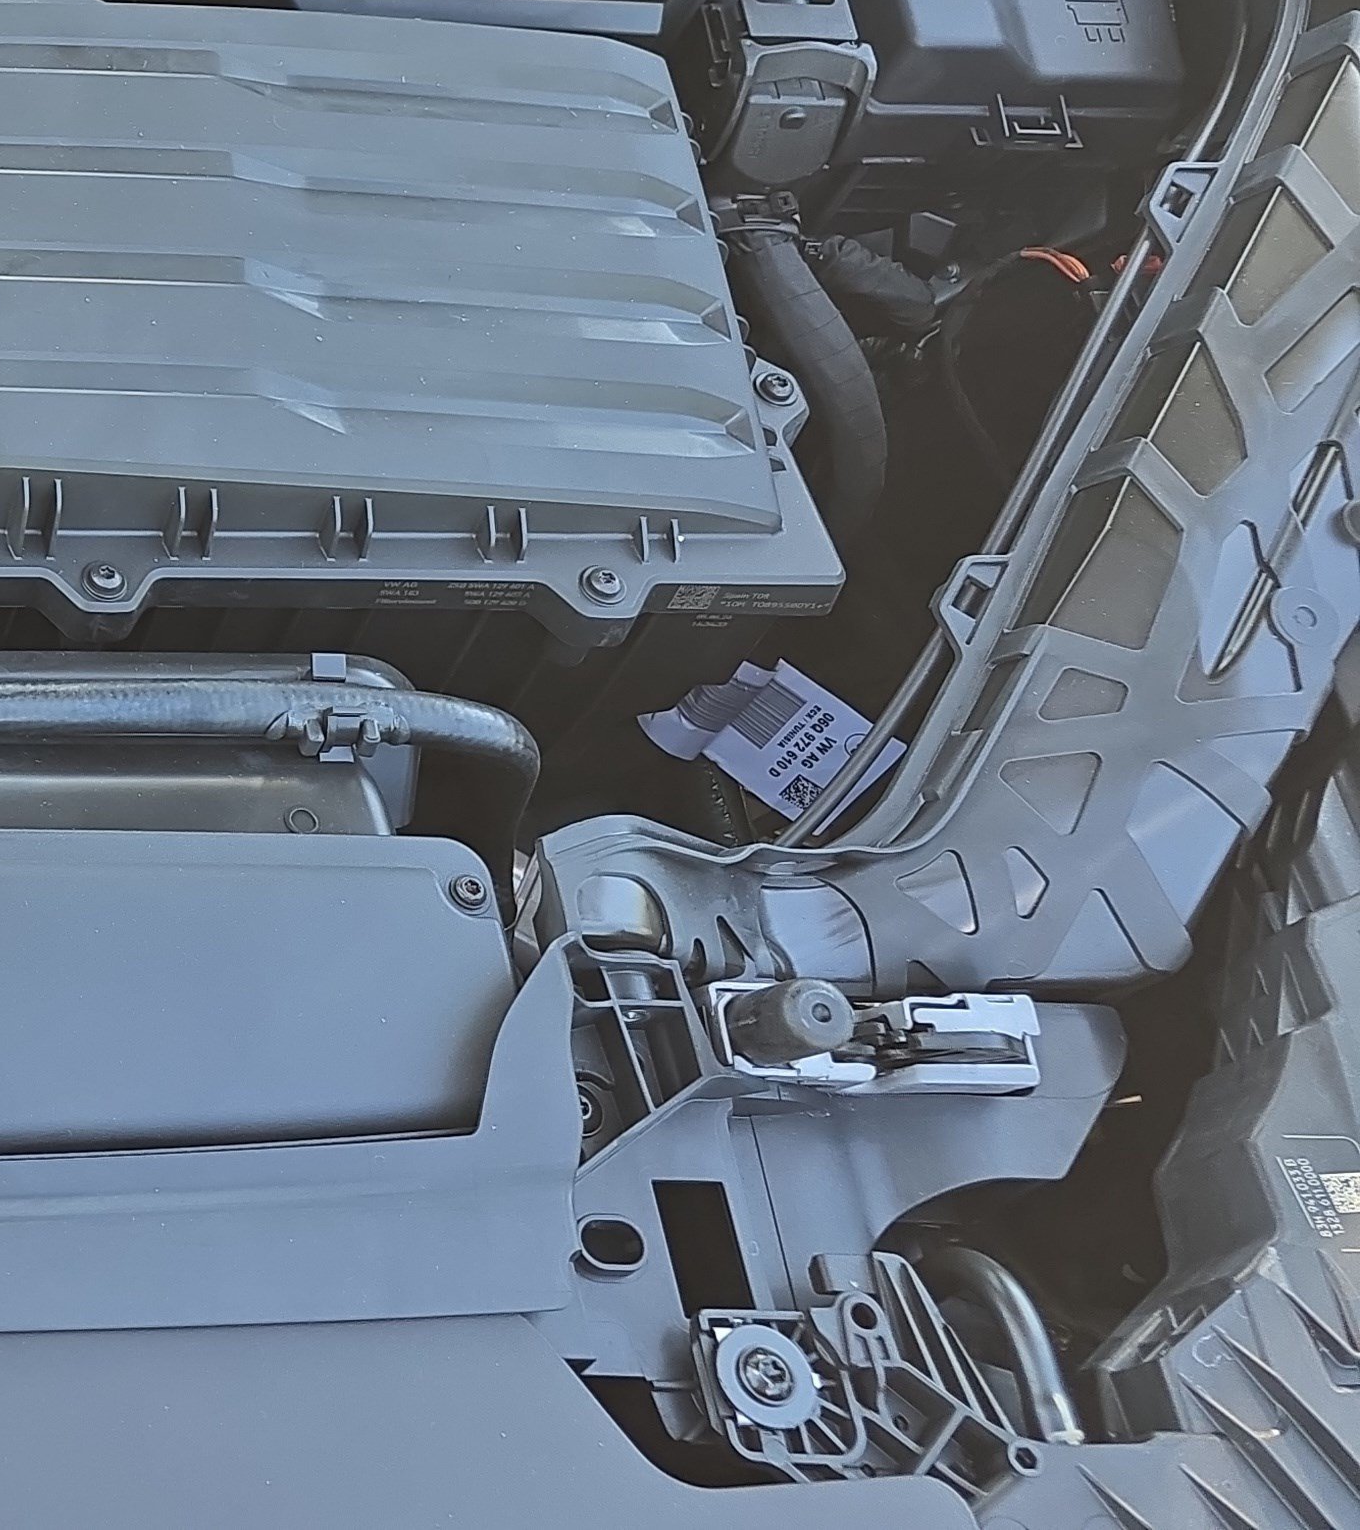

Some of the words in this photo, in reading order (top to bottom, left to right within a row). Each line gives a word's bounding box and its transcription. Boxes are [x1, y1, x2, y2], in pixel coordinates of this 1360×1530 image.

[383, 580, 401, 589] VW
[401, 581, 418, 589] AG
[809, 710, 836, 735] 06Q
[776, 720, 806, 750] TUNISIA
[791, 730, 817, 754] 972
[813, 735, 839, 756] VW
[774, 748, 800, 771] 610
[799, 750, 821, 771] AG
[766, 766, 782, 780] D
